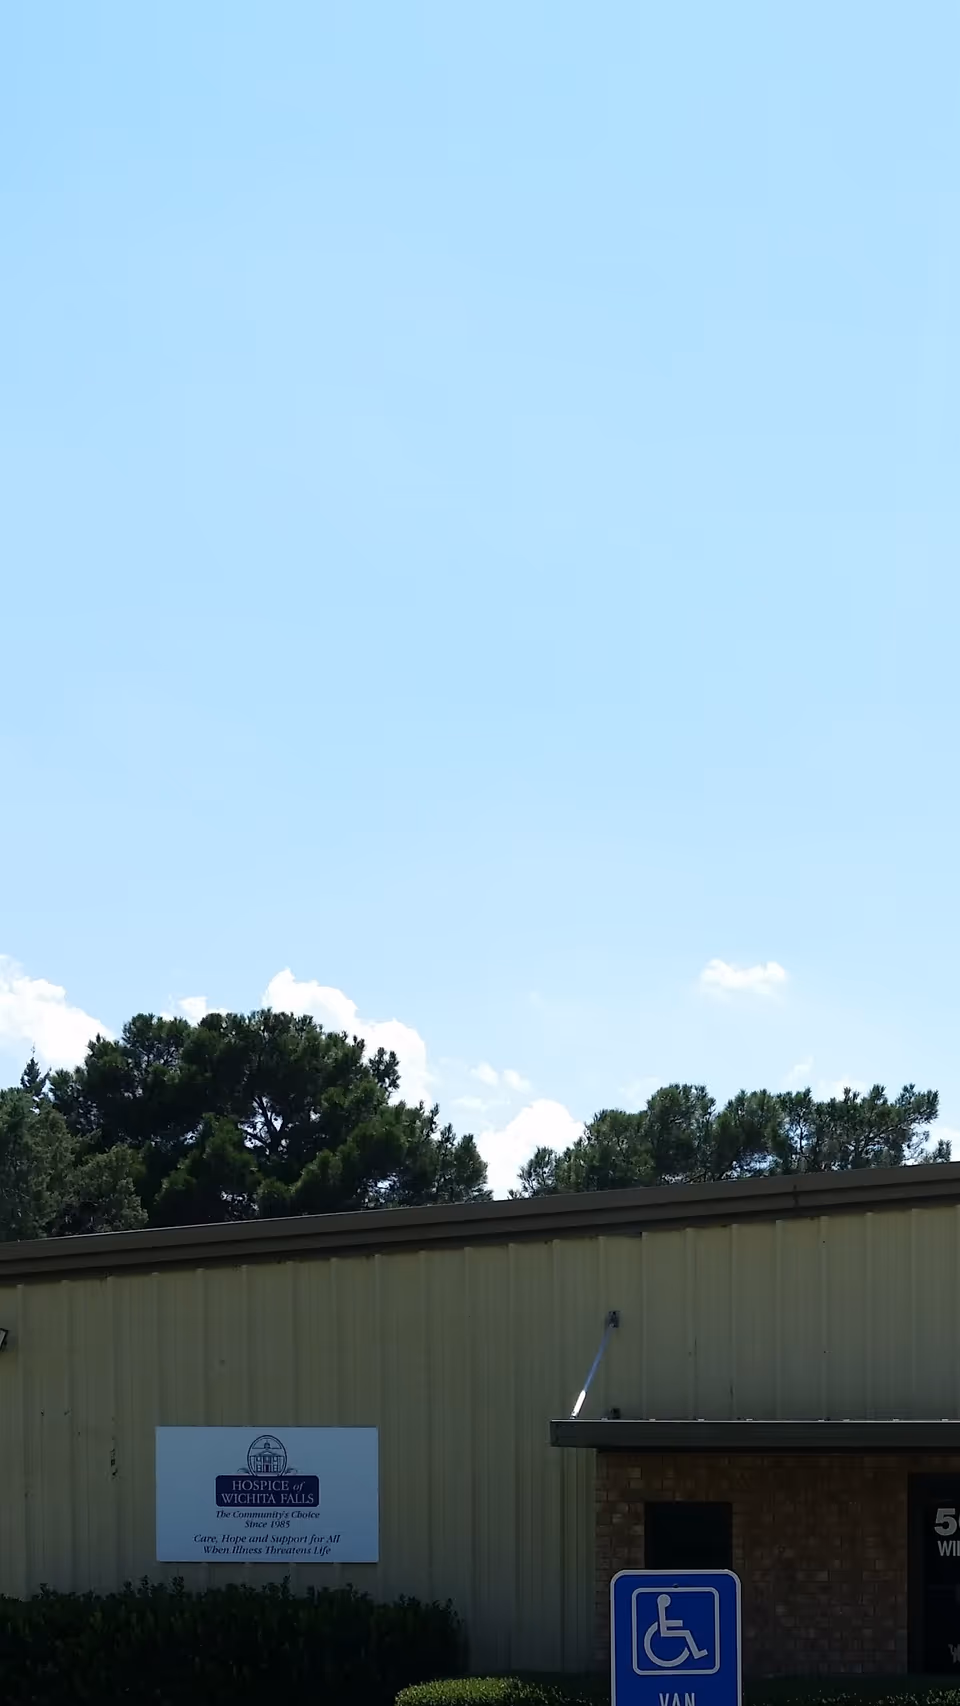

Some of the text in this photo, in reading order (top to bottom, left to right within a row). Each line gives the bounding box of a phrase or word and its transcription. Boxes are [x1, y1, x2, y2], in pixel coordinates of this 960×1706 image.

[232, 1480, 306, 1492] HOSPICE of
[221, 1493, 314, 1504] WICHITA FALLS
[216, 1510, 320, 1520] The Community's Choice
[244, 1520, 290, 1529] Since 1985
[221, 1534, 247, 1545] Hope
[249, 1534, 268, 1543] and
[270, 1534, 307, 1545] Support
[309, 1534, 324, 1546] for
[326, 1534, 340, 1543] All
[203, 1545, 331, 1557] When Illness Threatens Life
